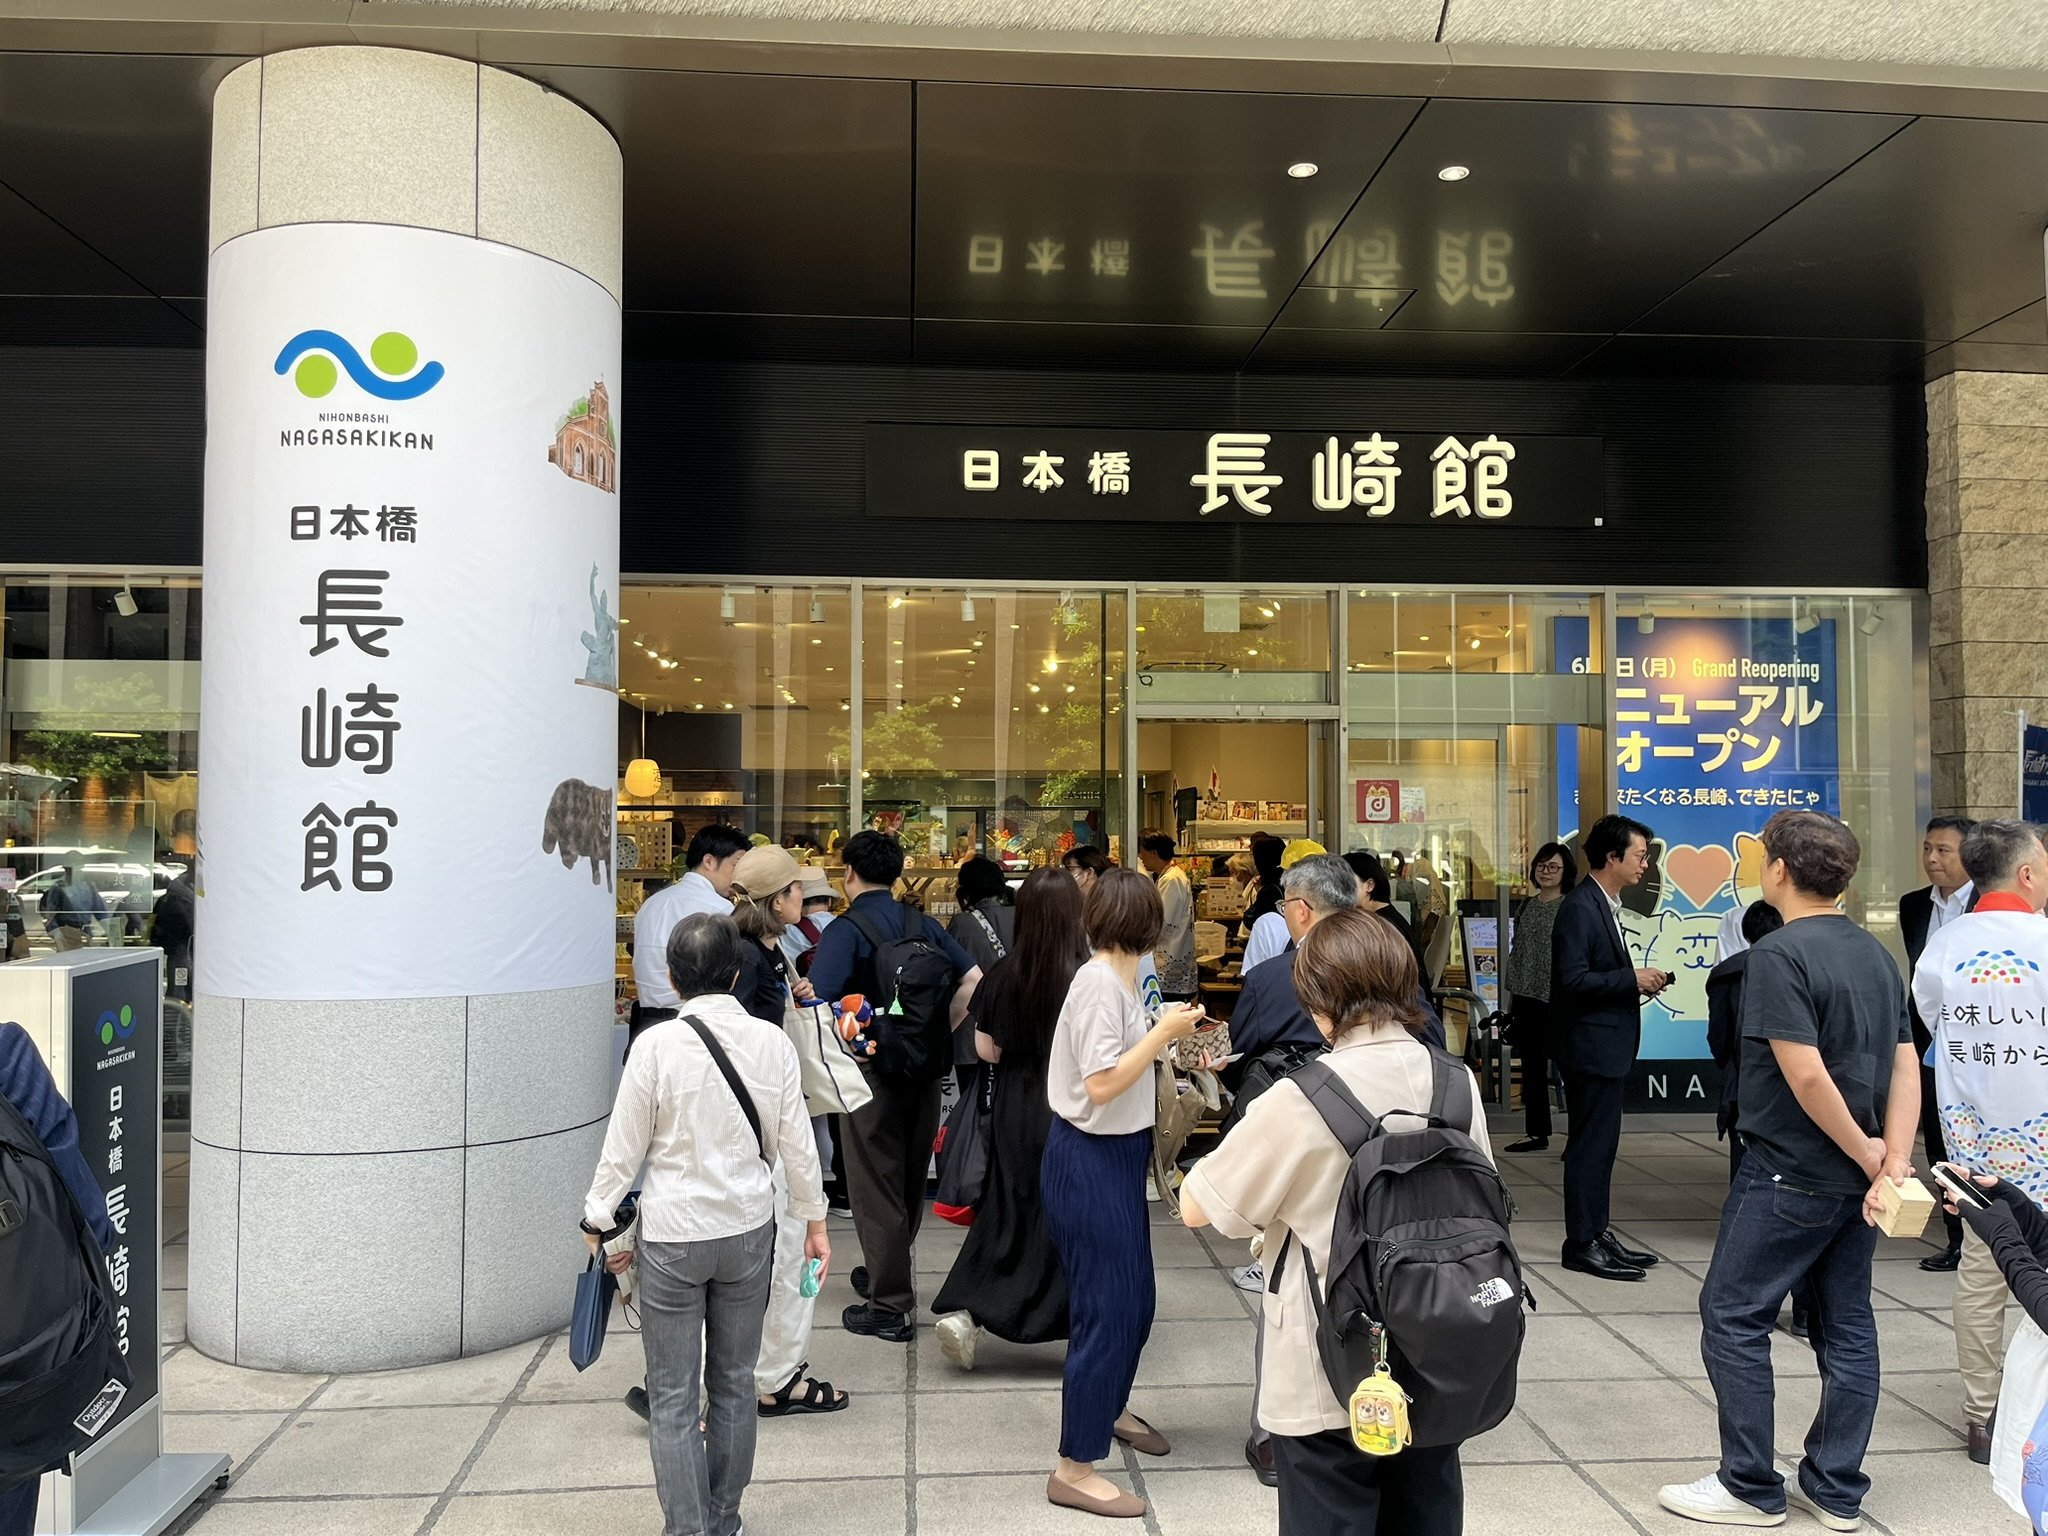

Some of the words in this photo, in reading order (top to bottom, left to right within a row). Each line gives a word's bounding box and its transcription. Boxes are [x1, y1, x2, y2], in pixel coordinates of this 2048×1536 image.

[318, 412, 390, 425] NIHONBASHI
[280, 429, 435, 452] NAGASAKIKAN
[962, 449, 1132, 496] 日本橋
[1190, 432, 1517, 519] 長崎館
[290, 503, 418, 544] 日本橋
[1692, 657, 1737, 680] Grand
[1741, 657, 1820, 684] Reopening
[299, 569, 404, 892] 長崎館
[1617, 727, 1781, 774] オープン
[1061, 790, 1103, 800] CASHIE
[96, 1050, 136, 1071] NAGASAKIKAN
[108, 1084, 124, 1175] 日本橋
[1469, 1287, 1499, 1303] NORTH
[1478, 1279, 1496, 1291] THE
[1481, 1294, 1502, 1308] FACE
